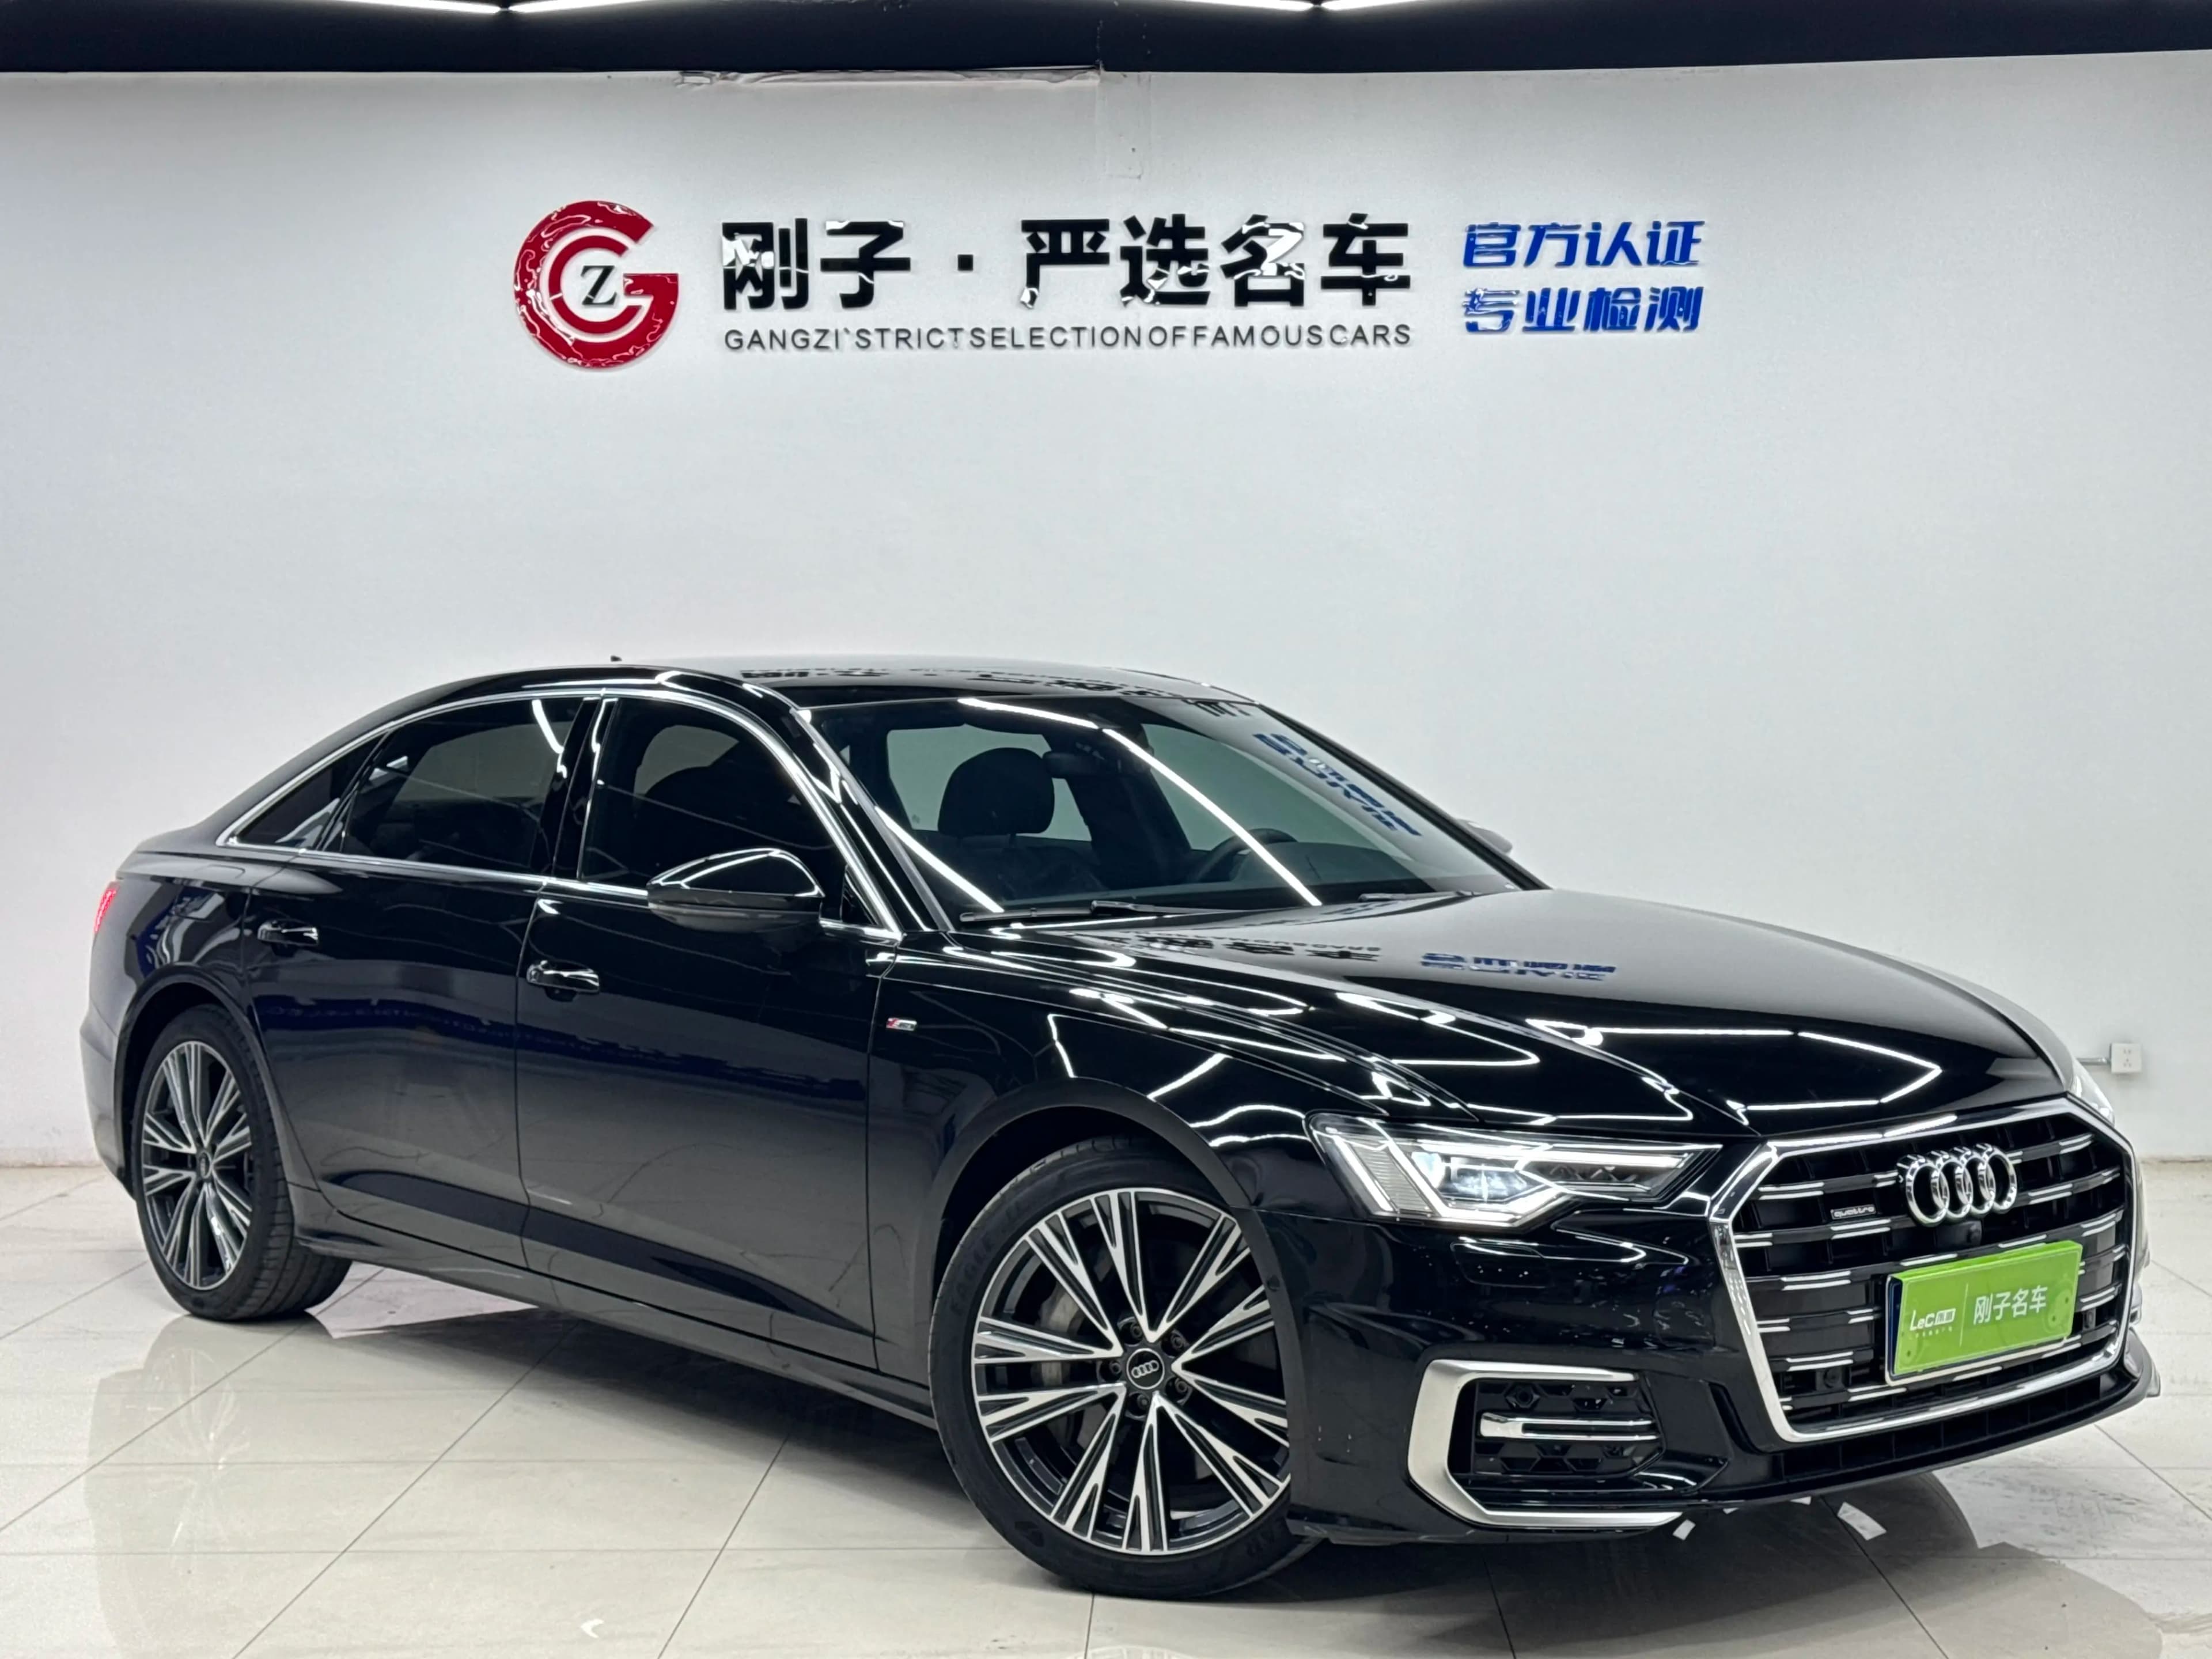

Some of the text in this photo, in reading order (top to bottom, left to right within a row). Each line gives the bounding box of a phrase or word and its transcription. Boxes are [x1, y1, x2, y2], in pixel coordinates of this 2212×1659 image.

[1463, 221, 1705, 268] 官方认证
[1462, 286, 1704, 332] 专业检测
[1973, 1285, 2048, 1325] 刚子名车
